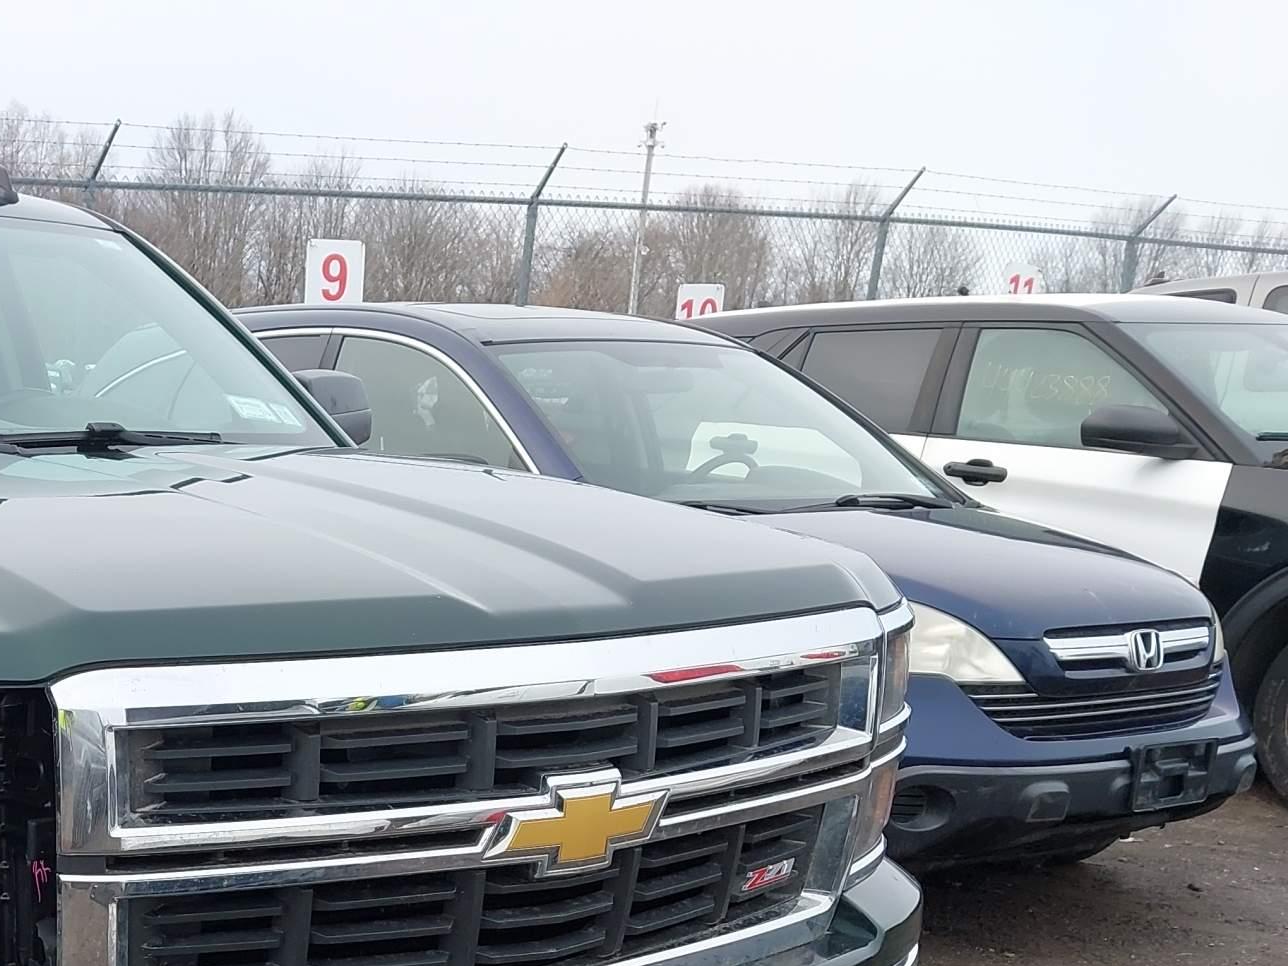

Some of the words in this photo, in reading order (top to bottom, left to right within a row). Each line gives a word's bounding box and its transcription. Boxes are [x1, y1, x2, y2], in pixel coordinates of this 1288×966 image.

[321, 253, 347, 301] 9
[680, 298, 718, 318] 10
[741, 857, 796, 892] Z71
